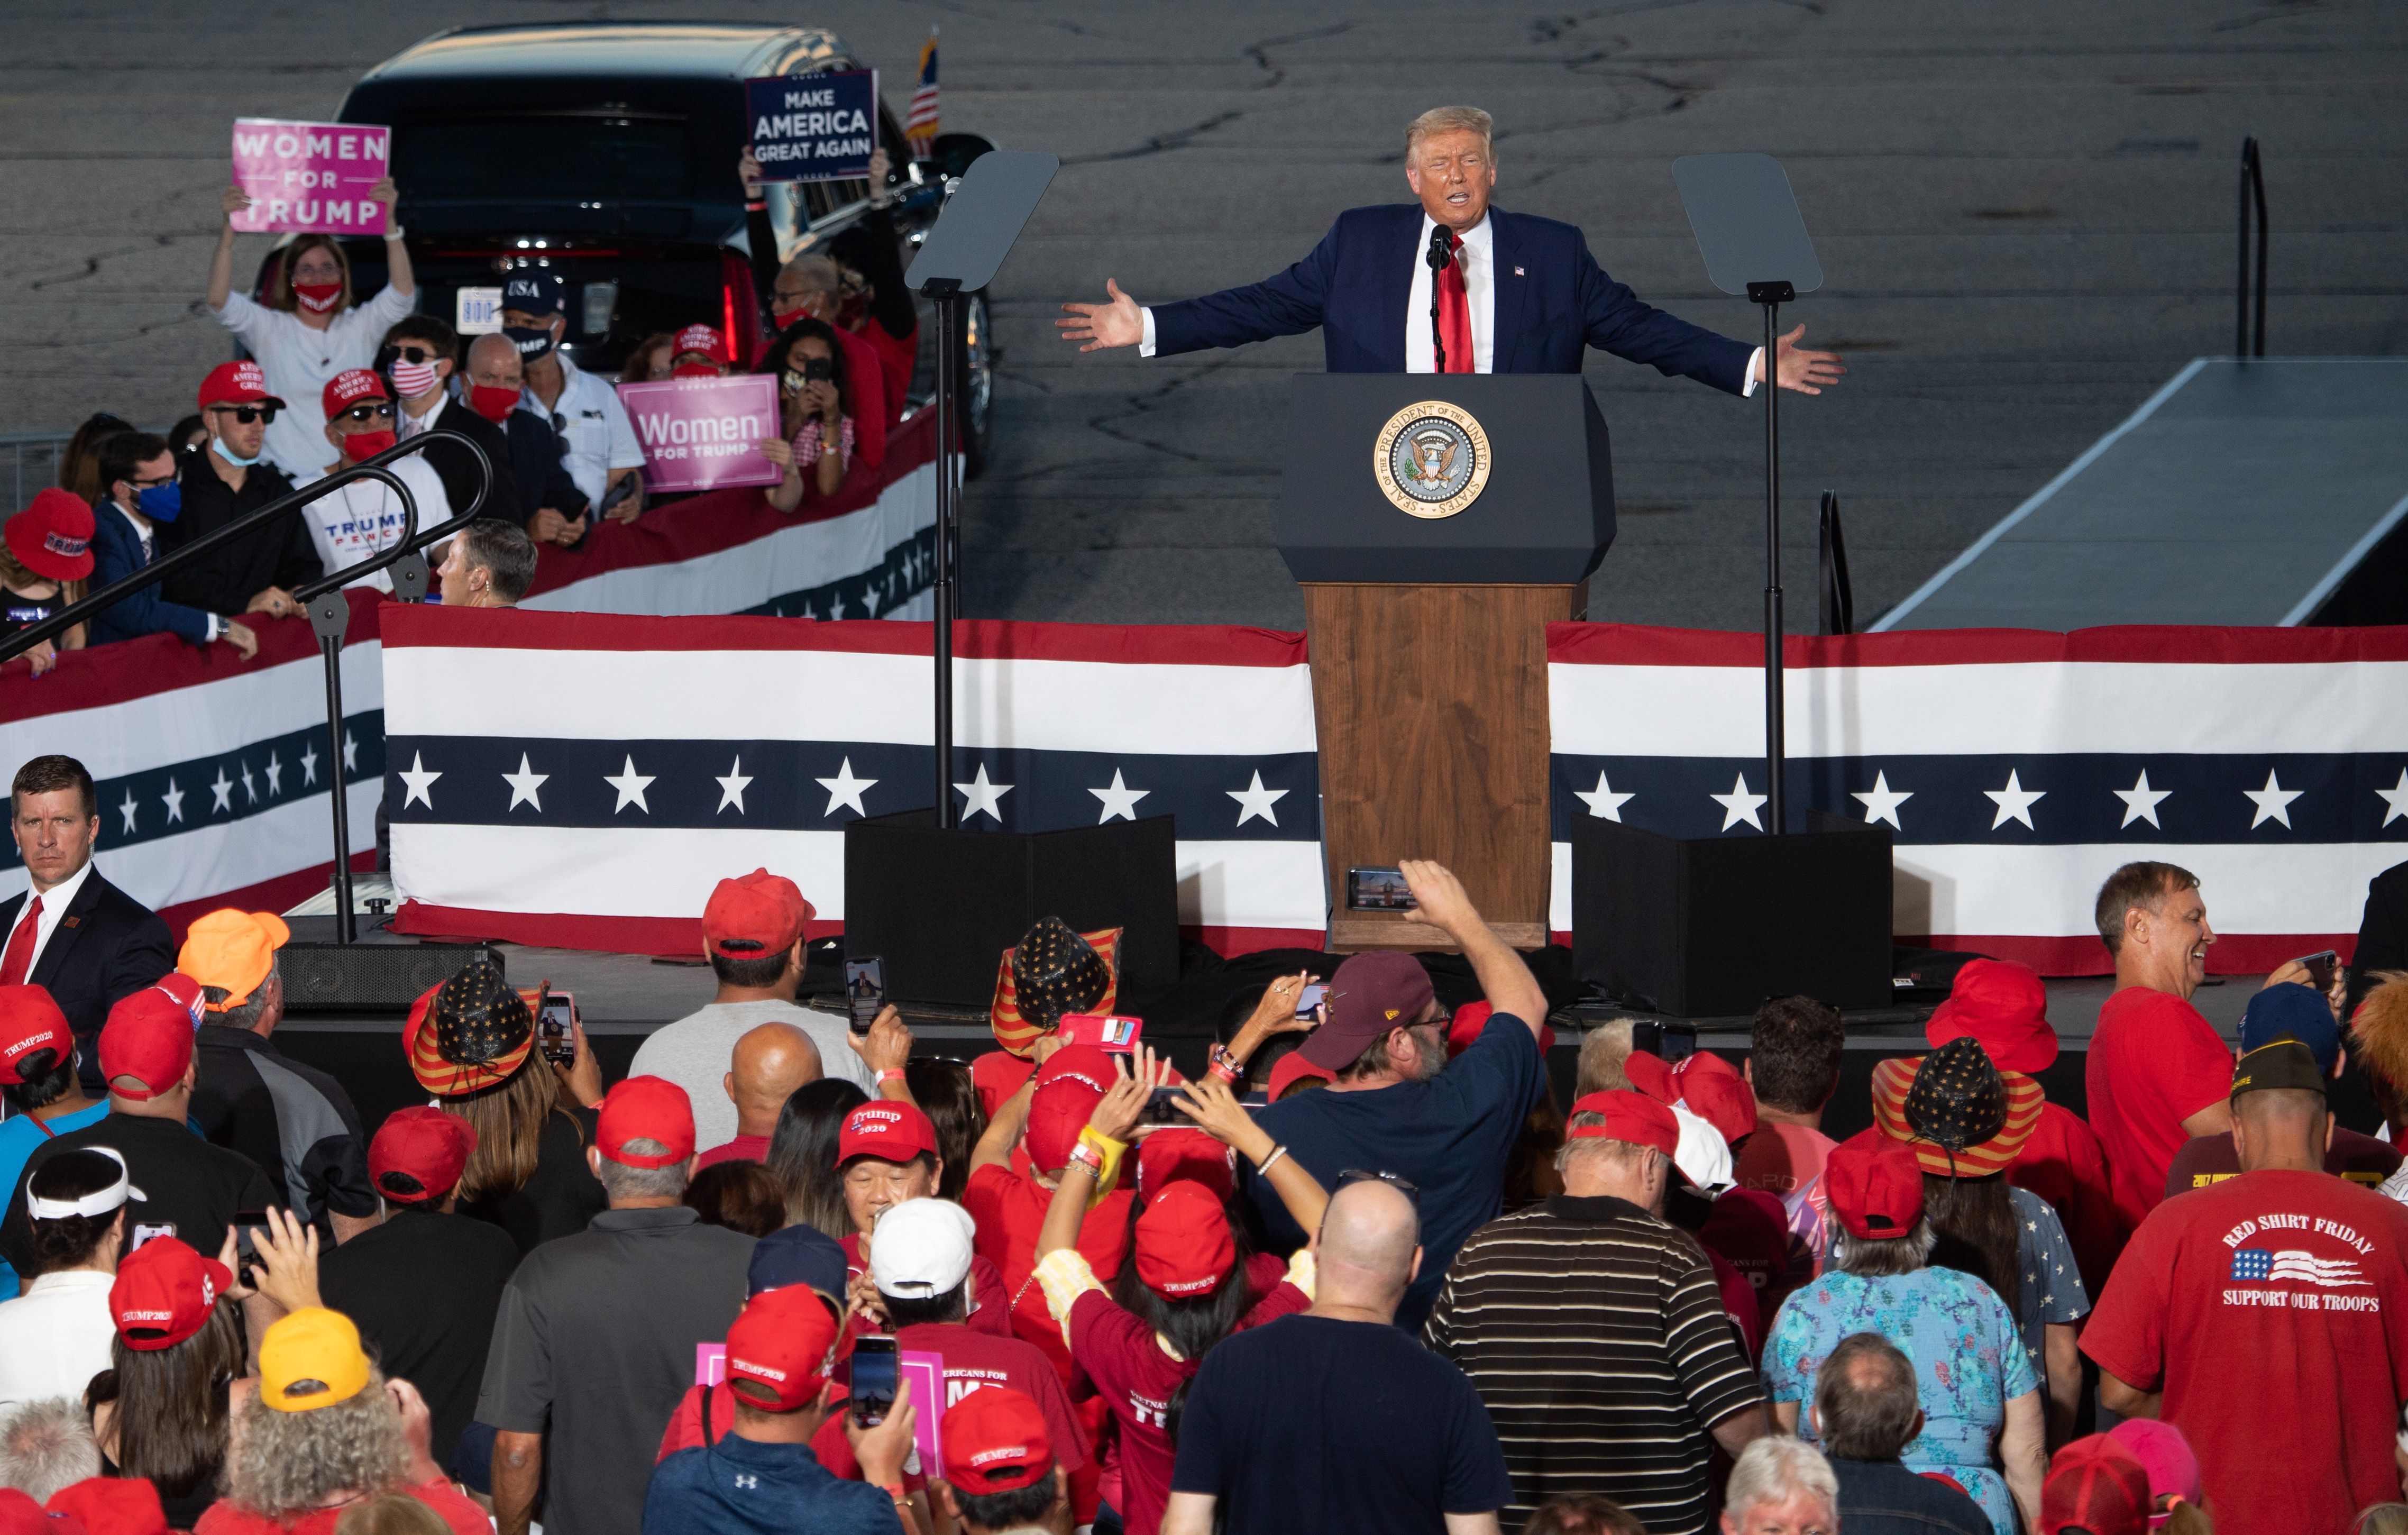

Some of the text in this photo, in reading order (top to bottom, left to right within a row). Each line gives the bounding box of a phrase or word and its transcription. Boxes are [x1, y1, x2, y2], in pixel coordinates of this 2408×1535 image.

[784, 88, 835, 109] MAKE
[754, 109, 869, 140] AMERICA
[236, 133, 386, 161] WOMEN
[754, 138, 871, 162] GREAT AGAIN
[283, 170, 337, 189] FOR
[248, 198, 379, 225] TRUMP
[507, 279, 541, 298] USA
[679, 333, 718, 346] AMERICA
[682, 341, 711, 351] GREAT
[333, 376, 373, 396] AMERICA
[338, 370, 360, 383] KEEP
[340, 384, 371, 400] GREAT
[637, 412, 760, 446] Women
[654, 442, 750, 461] FOR TRUMP
[1379, 405, 1487, 514] SEAL OF THE PRESIDENT OF THE UNITED STATES
[45, 532, 88, 554] TRUM
[4, 1031, 53, 1057] TRUMP2020
[853, 1110, 902, 1125] Trump
[858, 1125, 887, 1136] 2020
[2193, 1174, 2211, 1188] 2017
[2222, 1214, 2375, 1256] RED SHIRT FRIDAY
[1164, 1275, 1215, 1292] TRUMP2020
[2222, 1290, 2379, 1312] SUPPORT OUR TROOPS
[122, 1311, 172, 1322] TRUMP2020
[733, 1359, 785, 1382] TRUMP2020
[942, 1369, 1007, 1381] ERICANS FOR
[970, 1446, 1028, 1467] TRUMP2020
